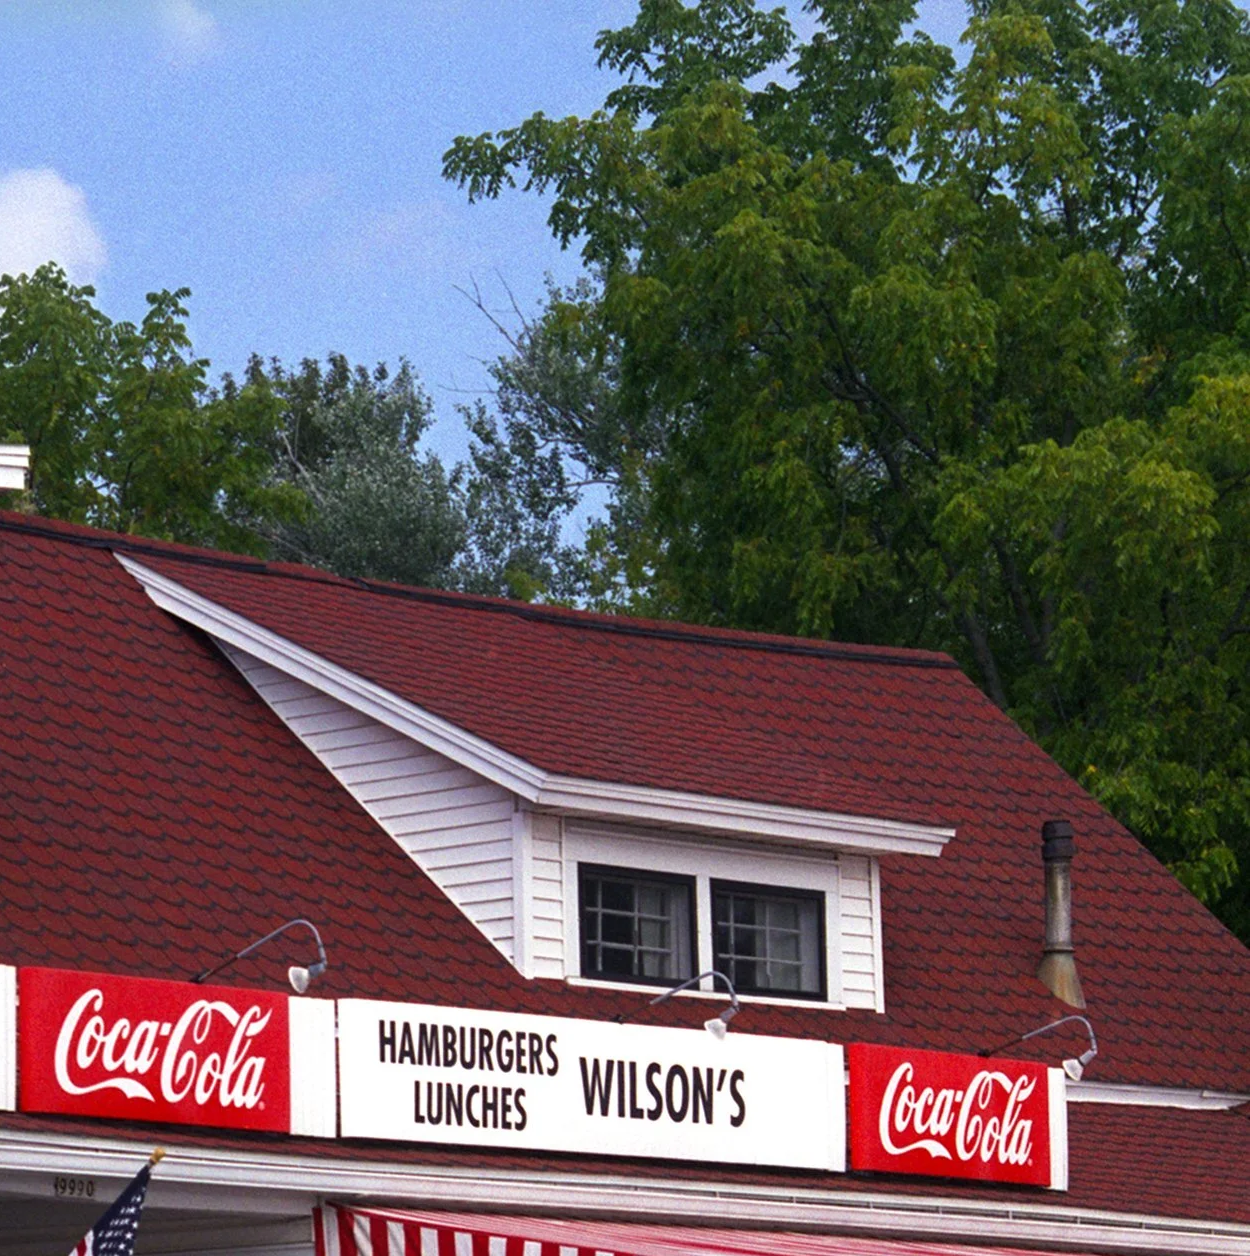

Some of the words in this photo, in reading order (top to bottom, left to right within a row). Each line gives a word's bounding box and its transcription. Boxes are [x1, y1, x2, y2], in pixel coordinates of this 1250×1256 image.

[54, 988, 272, 1110] Coca-Cola
[379, 1020, 559, 1077] HAMBURGERS
[414, 1080, 527, 1131] LUNCHES
[579, 1057, 745, 1128] WILSON'S
[878, 1061, 1036, 1166] Coca-Cola
